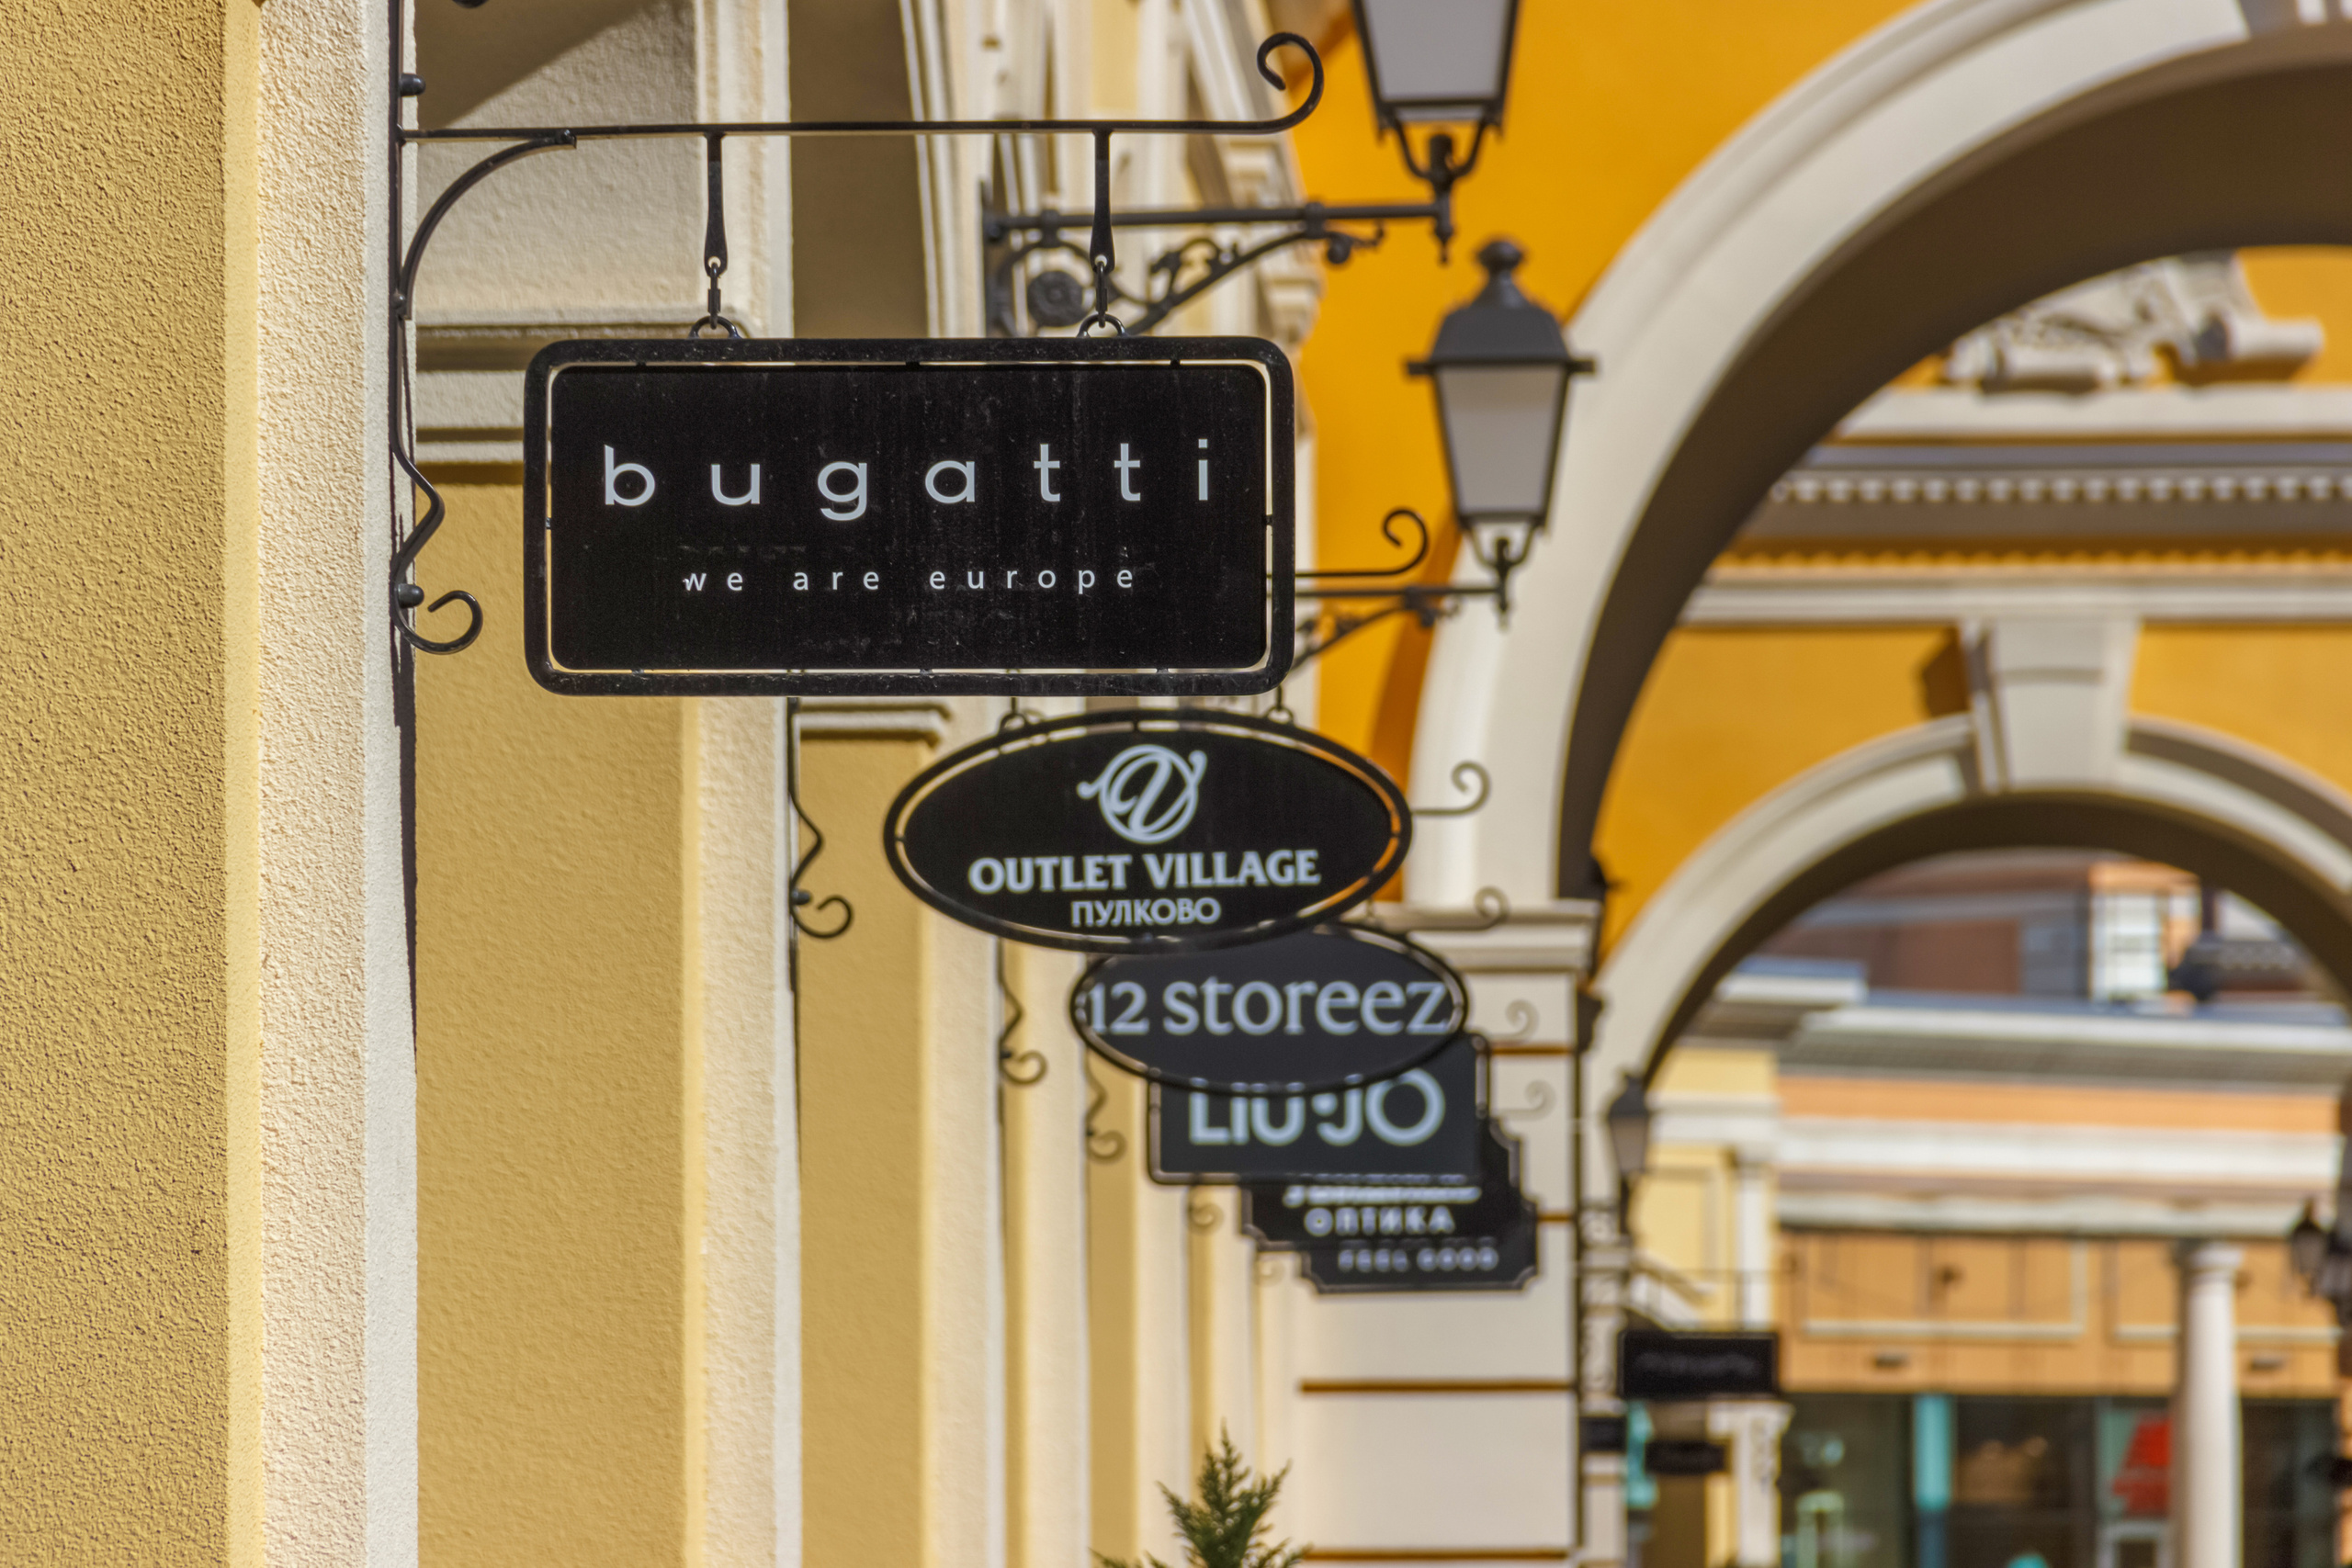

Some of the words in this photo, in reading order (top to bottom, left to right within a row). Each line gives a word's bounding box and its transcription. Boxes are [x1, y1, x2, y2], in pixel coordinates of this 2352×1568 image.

[603, 438, 1209, 522] bugatti
[683, 570, 745, 591] we
[793, 570, 880, 591] are
[928, 569, 1134, 595] europe
[967, 853, 1133, 895] OUTLET
[1141, 849, 1321, 889] VILLAGE
[1071, 897, 1222, 928] ПУЛКОВО
[1089, 981, 1150, 1035] 12
[1162, 976, 1448, 1036] storeez
[1304, 1205, 1455, 1236] ОПТИКА
